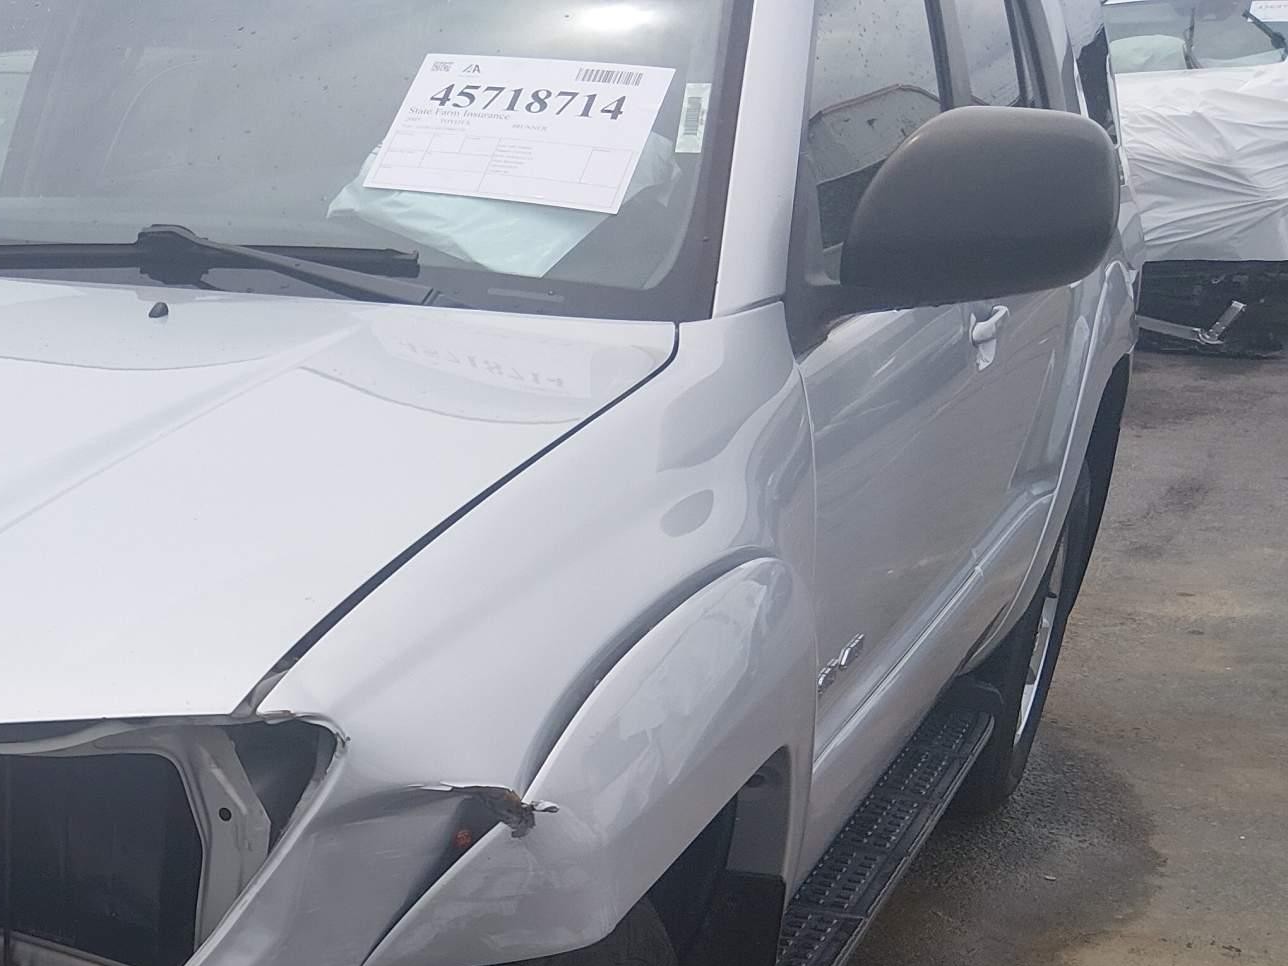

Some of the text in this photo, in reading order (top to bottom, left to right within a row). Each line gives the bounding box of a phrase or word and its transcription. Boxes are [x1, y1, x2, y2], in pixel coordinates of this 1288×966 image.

[408, 107, 511, 121] State Farm Insurance
[430, 83, 627, 121] 45718714
